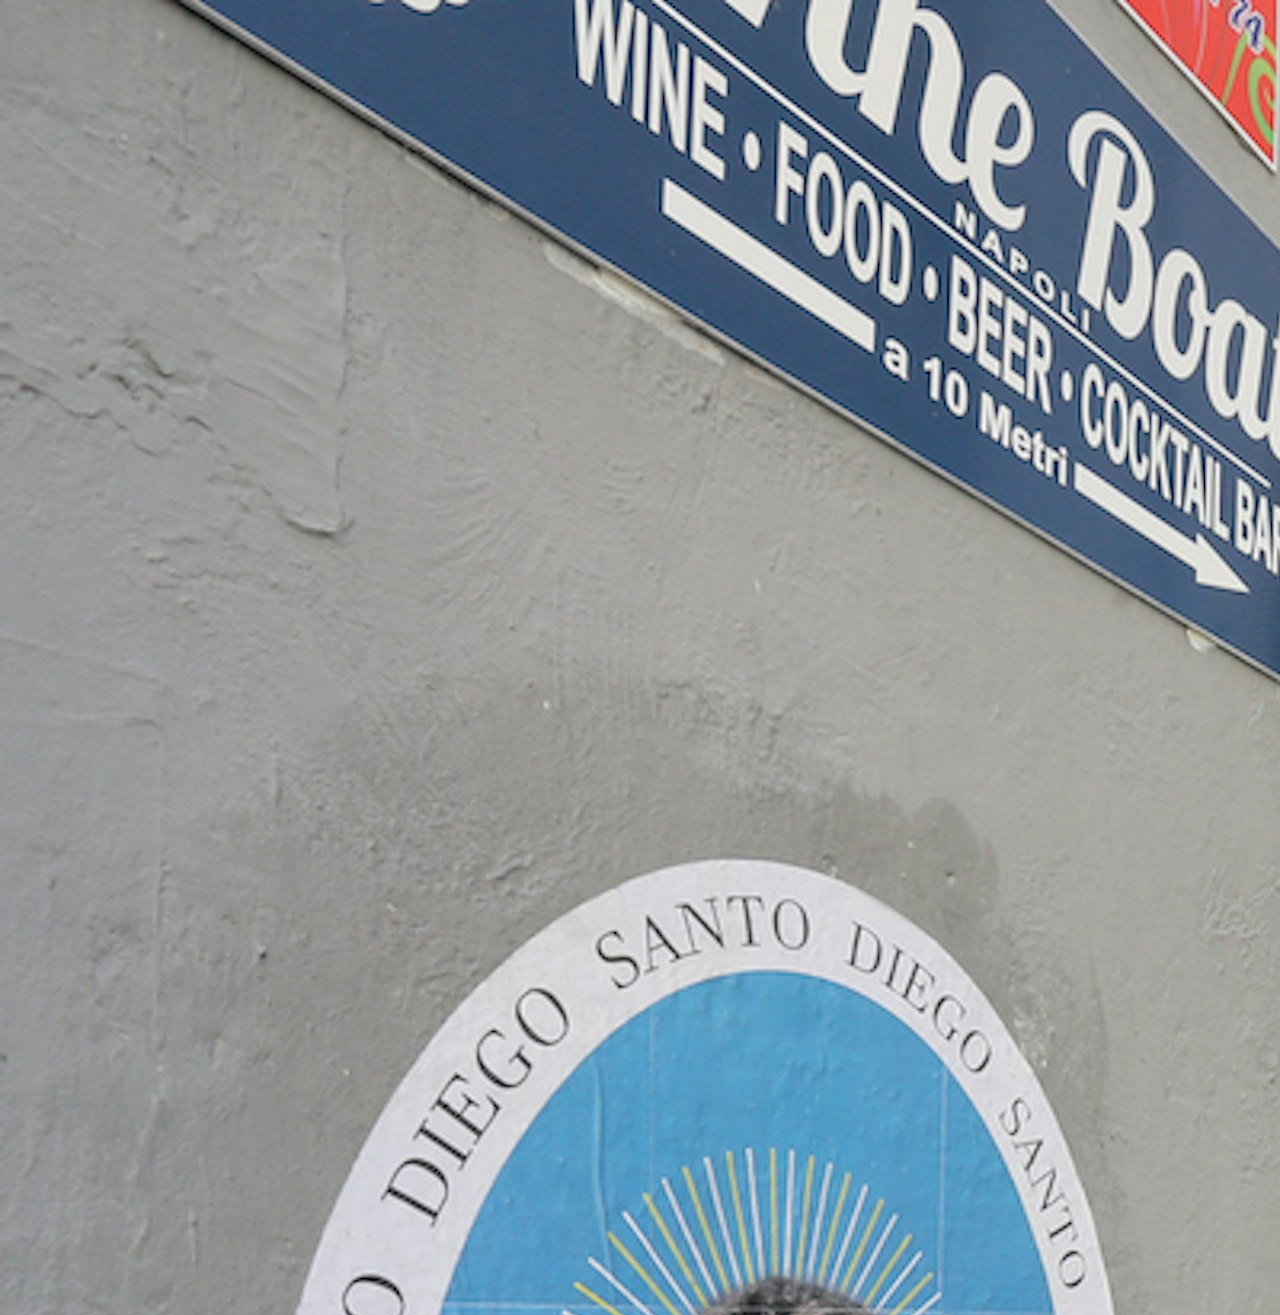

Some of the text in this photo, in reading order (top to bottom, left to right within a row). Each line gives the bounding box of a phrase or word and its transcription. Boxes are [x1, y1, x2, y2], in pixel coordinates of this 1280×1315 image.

[573, 0, 730, 181] WINE
[775, 120, 912, 306] FOOD
[948, 254, 1053, 414] BEER
[1080, 362, 1230, 541] COCKTAIL
[955, 202, 1092, 333] NAPOLI
[882, 338, 1068, 487] a 10 Metri
[596, 895, 810, 990] SANTO
[845, 921, 993, 1074] DIEGO
[381, 987, 570, 1227] DIEGO
[999, 1095, 1087, 1290] SANTO
